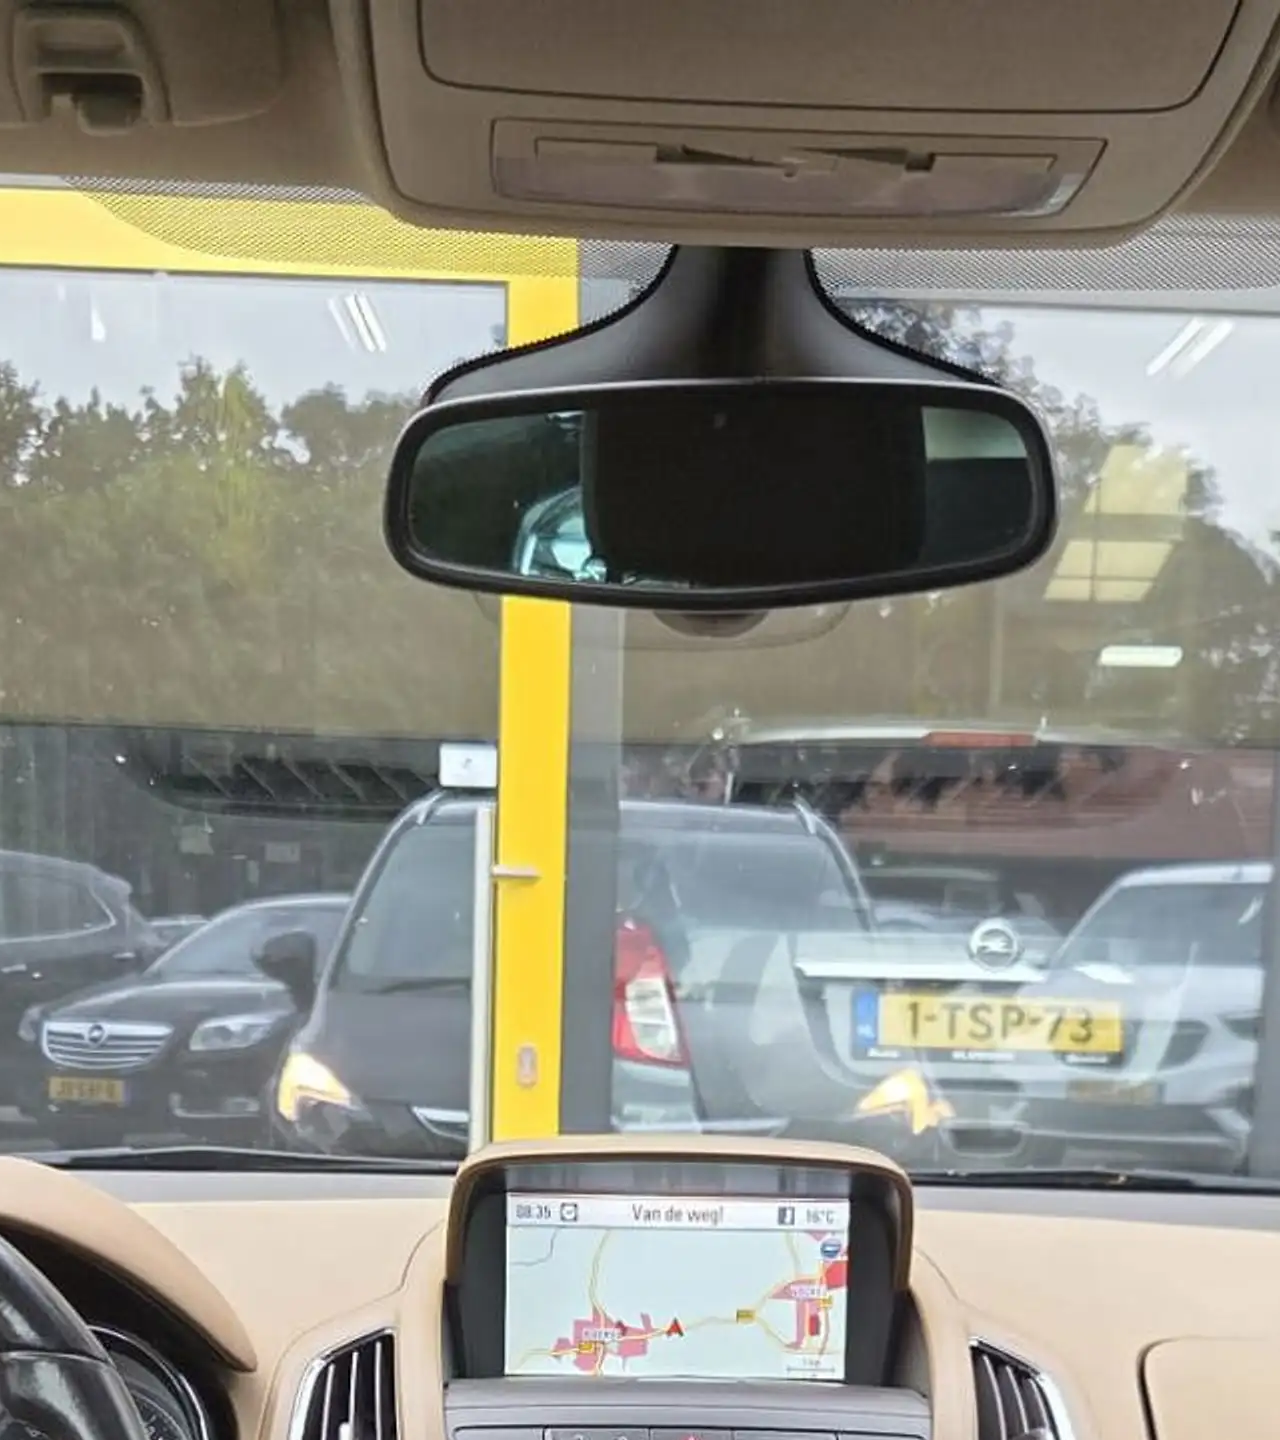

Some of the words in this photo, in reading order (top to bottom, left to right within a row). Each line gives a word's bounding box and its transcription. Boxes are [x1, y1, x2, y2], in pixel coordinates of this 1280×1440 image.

[906, 1001, 1095, 1044] 1-TSP-73
[632, 1204, 664, 1221] Van
[665, 1204, 683, 1221] de
[687, 1204, 725, 1226] weg!
